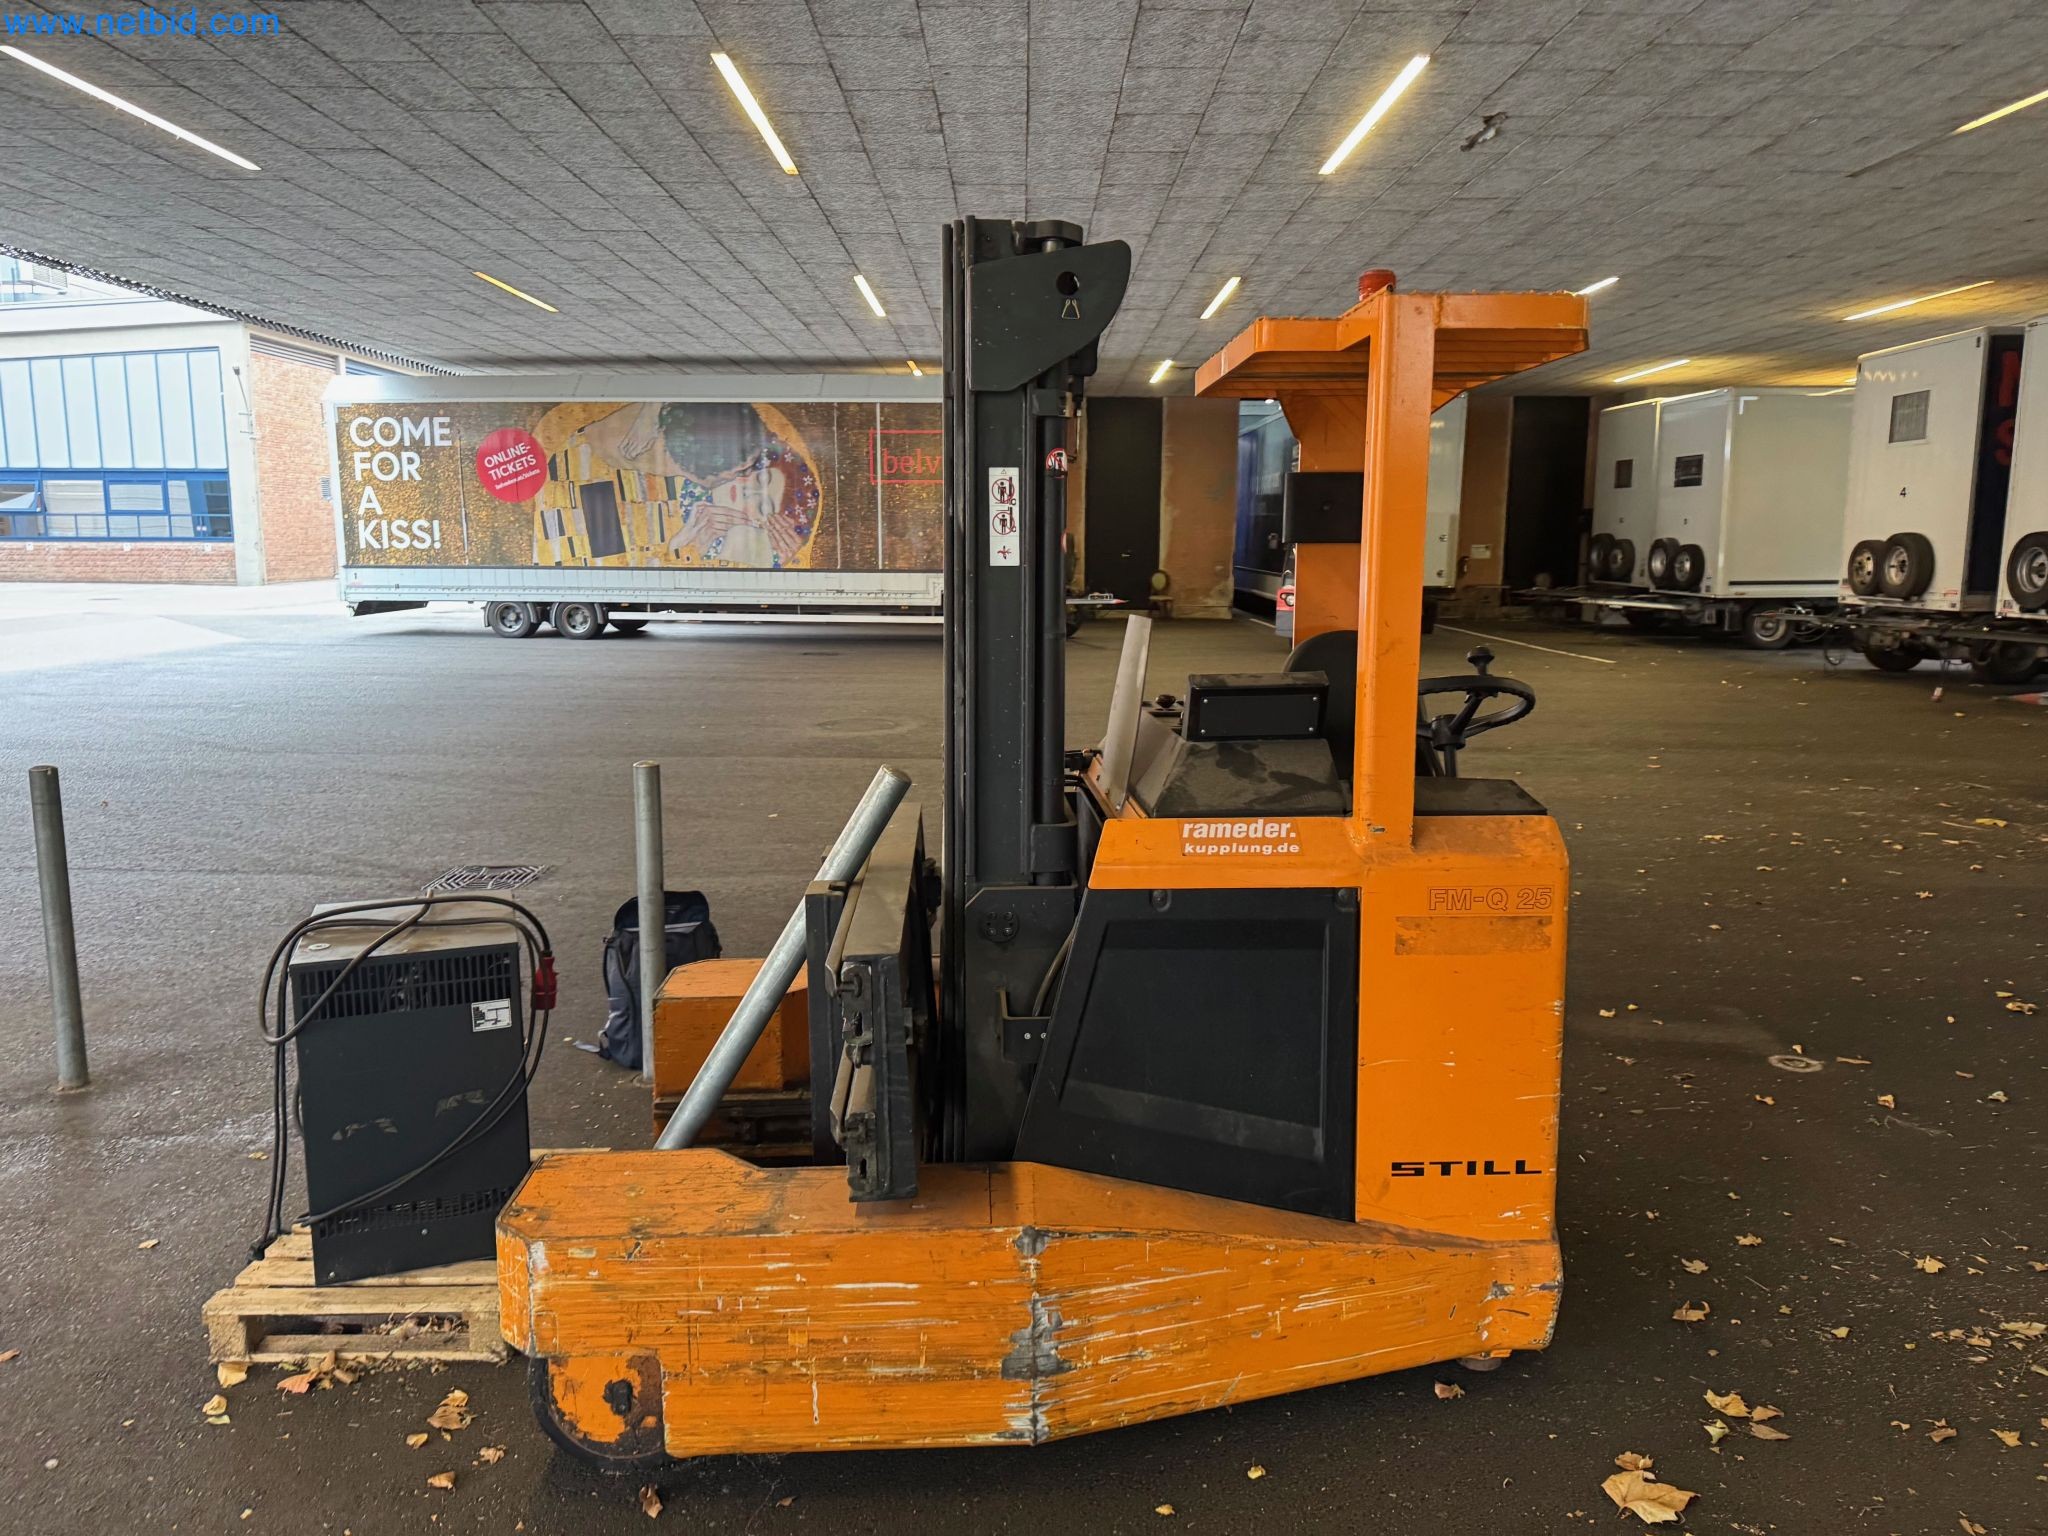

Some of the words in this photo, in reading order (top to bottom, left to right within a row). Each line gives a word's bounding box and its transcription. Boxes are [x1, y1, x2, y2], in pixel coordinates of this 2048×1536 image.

[350, 416, 452, 447] COME
[353, 451, 422, 482] FOR
[484, 442, 531, 468] ONLINE-
[488, 454, 537, 481] TICKETS
[357, 485, 383, 515] A
[1899, 487, 1907, 498] 4
[358, 519, 442, 550] KISS!
[1182, 818, 1297, 839] rameder.
[1184, 843, 1300, 856] kupplung.de
[1429, 888, 1508, 911] FM-Q
[1516, 888, 1552, 910] 25
[1391, 1160, 1542, 1177] STILL
